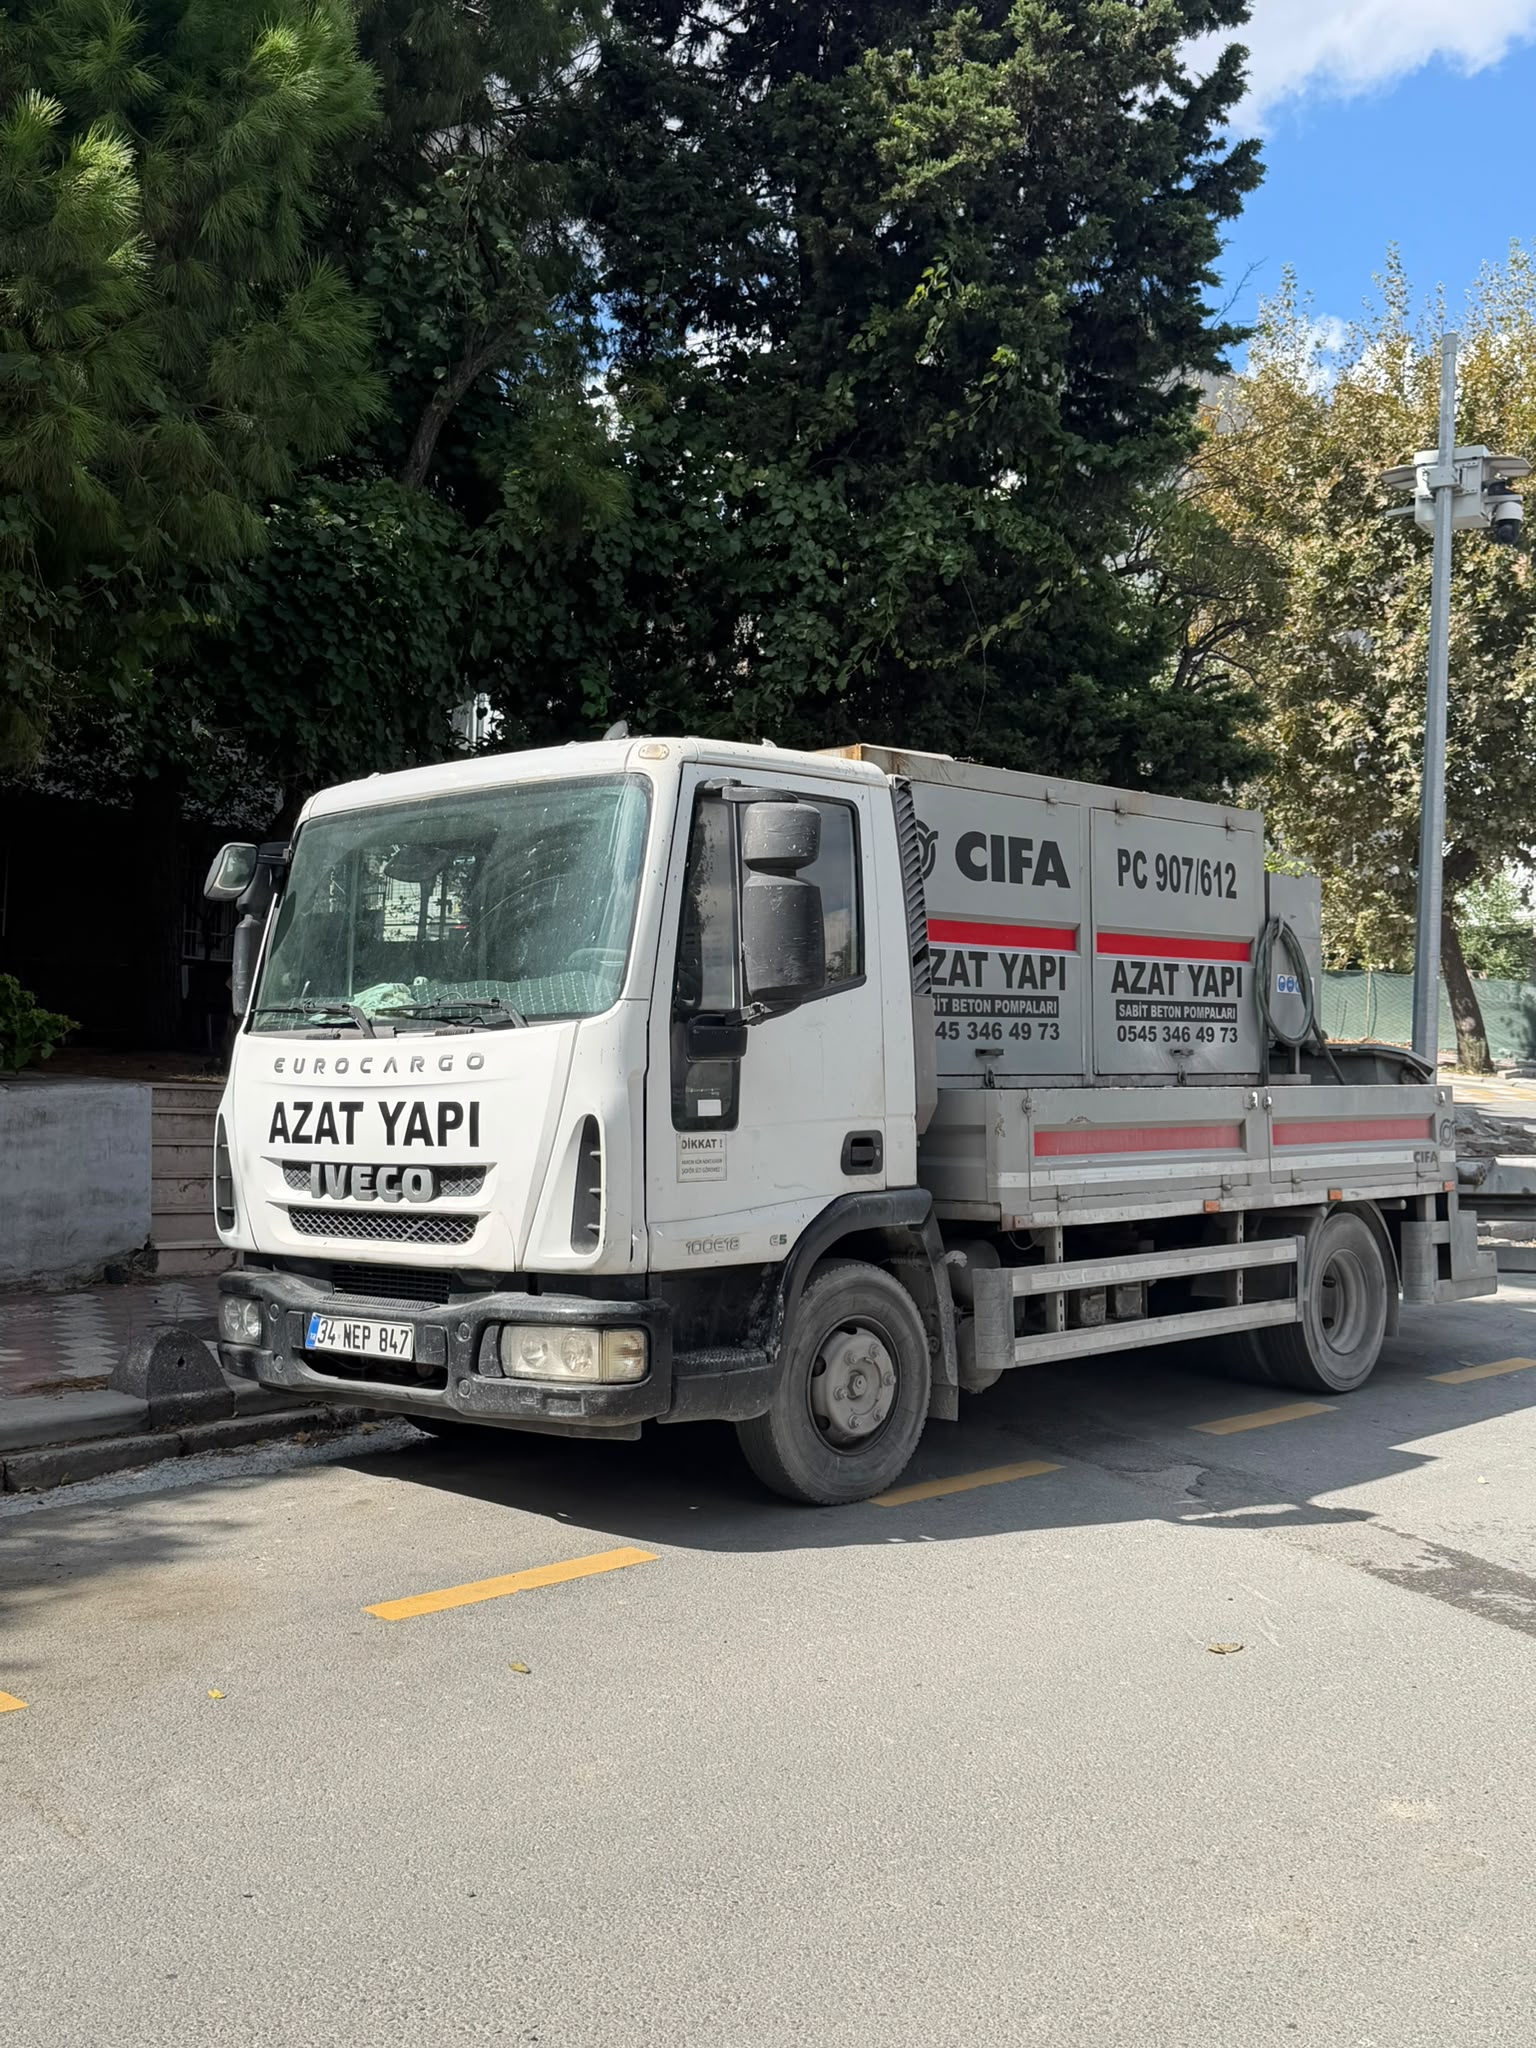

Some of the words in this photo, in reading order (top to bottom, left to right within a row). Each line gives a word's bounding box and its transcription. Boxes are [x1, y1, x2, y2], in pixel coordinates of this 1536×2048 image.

[955, 830, 1071, 889] CIFA
[1118, 848, 1148, 889] PC
[1155, 853, 1237, 899] 907/612
[930, 949, 988, 987] ZAT
[998, 952, 1066, 991] YAPI
[1111, 960, 1179, 996] AZAT
[1187, 964, 1242, 998] YAPI
[952, 998, 991, 1013] BETON
[995, 1000, 1057, 1014] POMPALARI
[1119, 1002, 1148, 1017] SABİT
[1151, 1005, 1181, 1018] BETON
[1184, 1006, 1235, 1020] POMPALARI
[935, 1021, 960, 1041] 45
[967, 1021, 1003, 1041] 346
[1008, 1022, 1032, 1041] 49
[1038, 1022, 1060, 1041] 73
[1117, 1025, 1157, 1042] 0545
[1162, 1026, 1191, 1043] 346
[1195, 1026, 1215, 1043] 49
[1219, 1027, 1238, 1043] 73
[273, 1053, 485, 1075] EUROCARGO
[268, 1101, 363, 1146] AZAT
[378, 1101, 480, 1147] YAPI
[681, 1137, 717, 1150] DİKKAT
[1413, 1151, 1438, 1163] CIFA
[310, 1162, 438, 1203] IVECO
[317, 1320, 336, 1346] 34
[343, 1323, 371, 1350] NEP
[379, 1327, 409, 1355] 847
